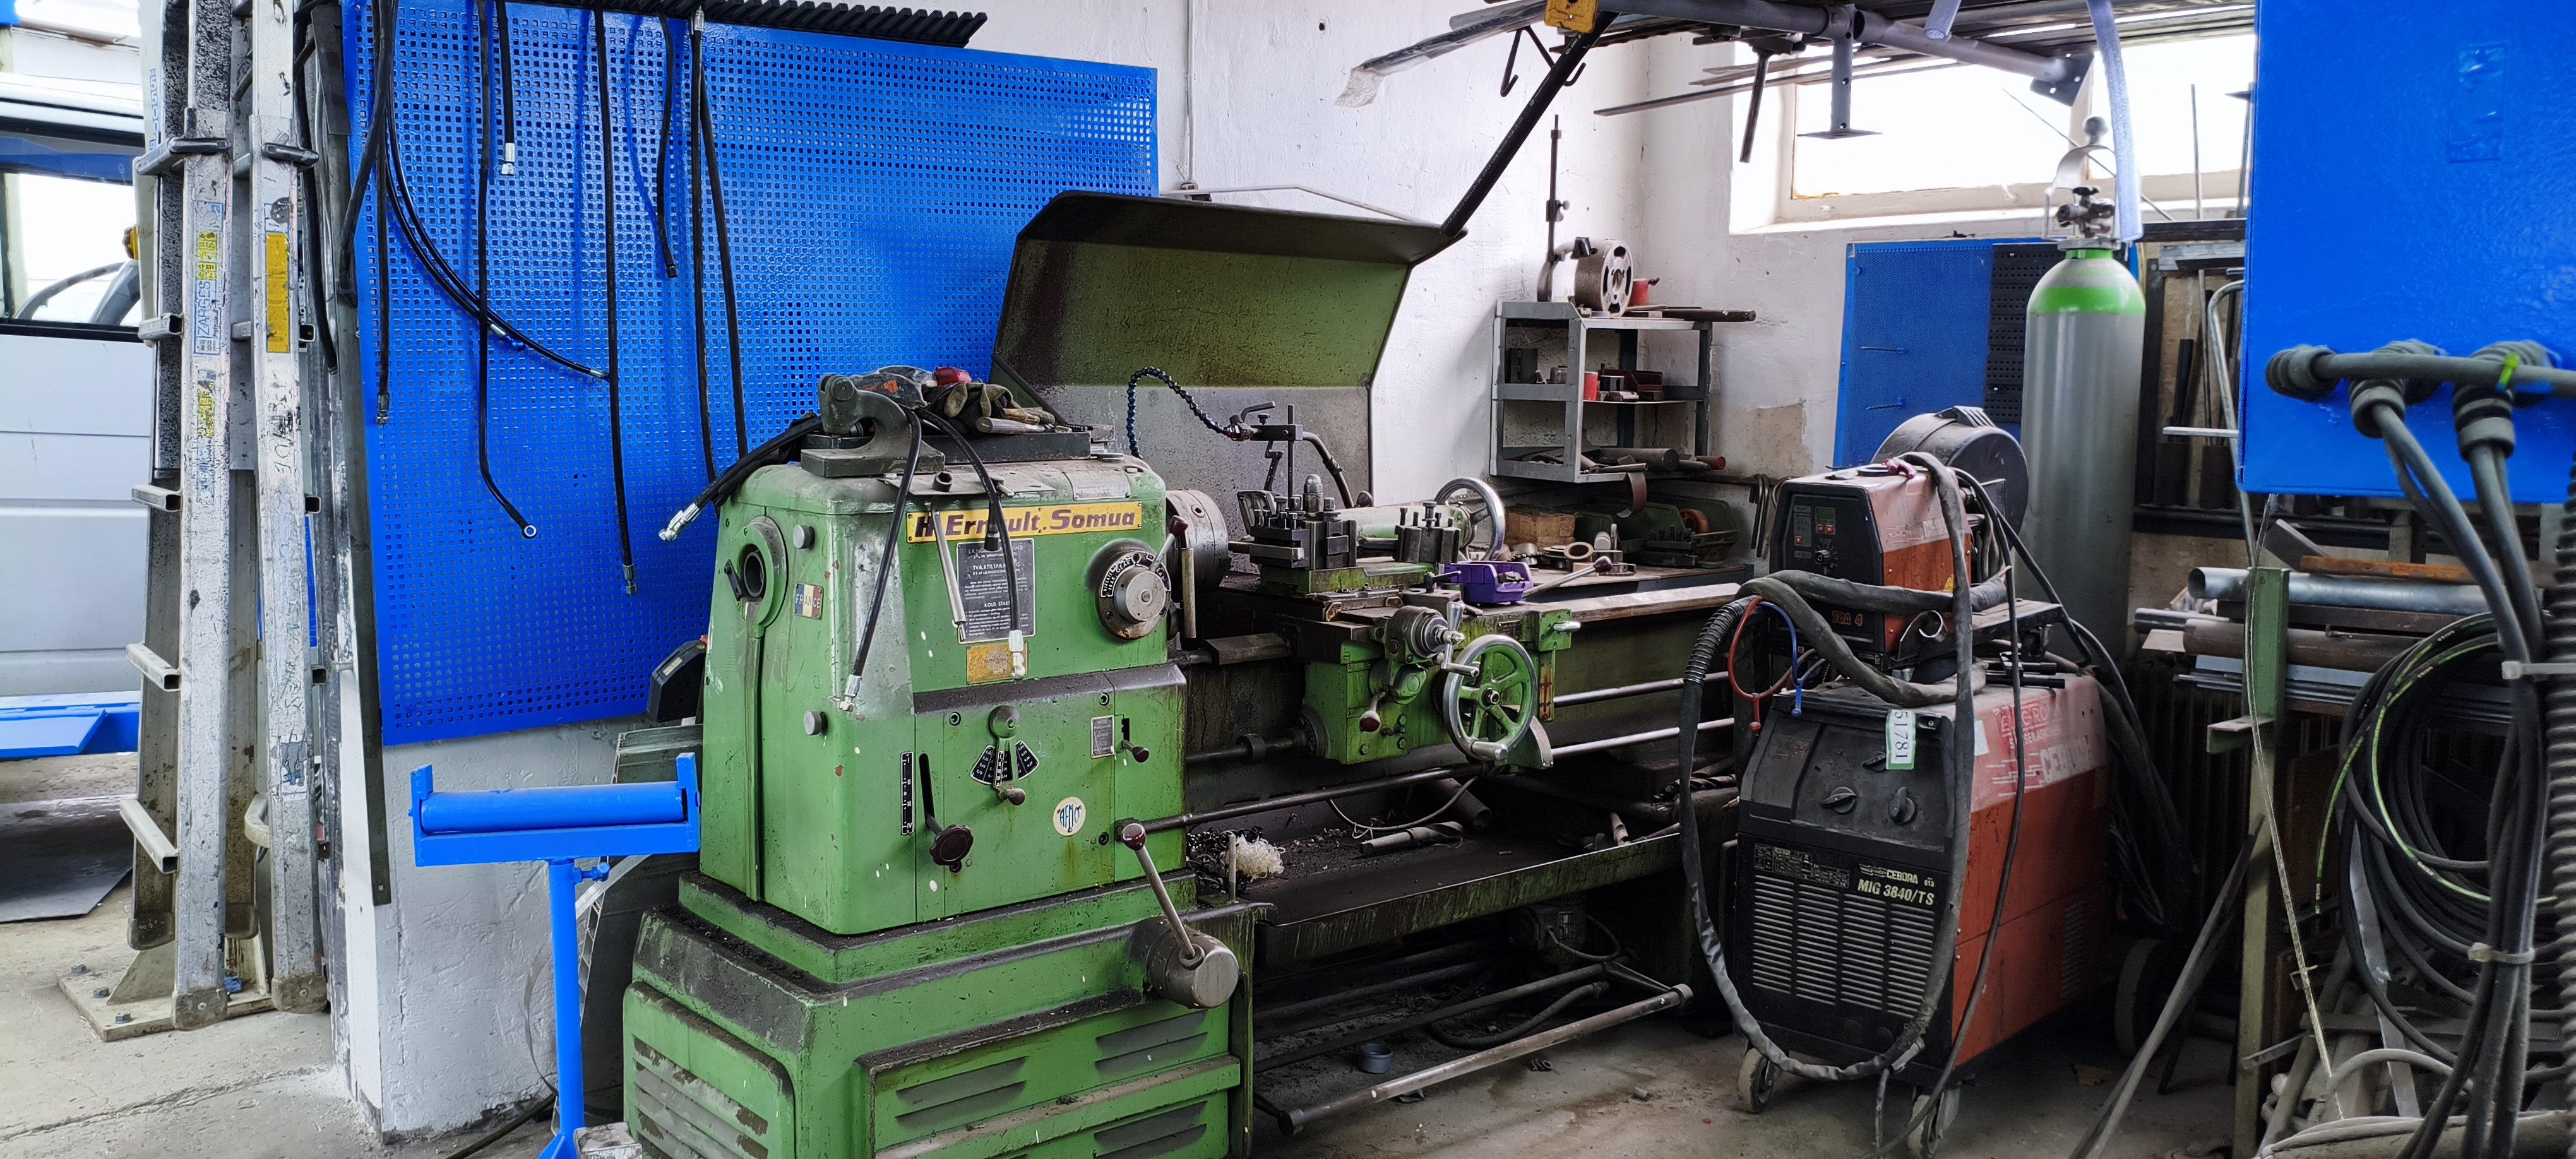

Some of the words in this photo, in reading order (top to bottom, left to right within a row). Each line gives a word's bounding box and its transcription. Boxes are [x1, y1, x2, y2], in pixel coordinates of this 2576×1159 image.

[198, 281, 211, 336] ZARGES
[1049, 509, 1135, 530] Somua
[796, 593, 821, 609] FRANCE
[1832, 610, 1852, 626] TDA
[1854, 614, 1863, 627] 4
[1894, 711, 1909, 760] 51781
[1886, 869, 1919, 884] CEBORA
[1857, 878, 1881, 895] MIG
[1883, 884, 1935, 905] 3840/TS
